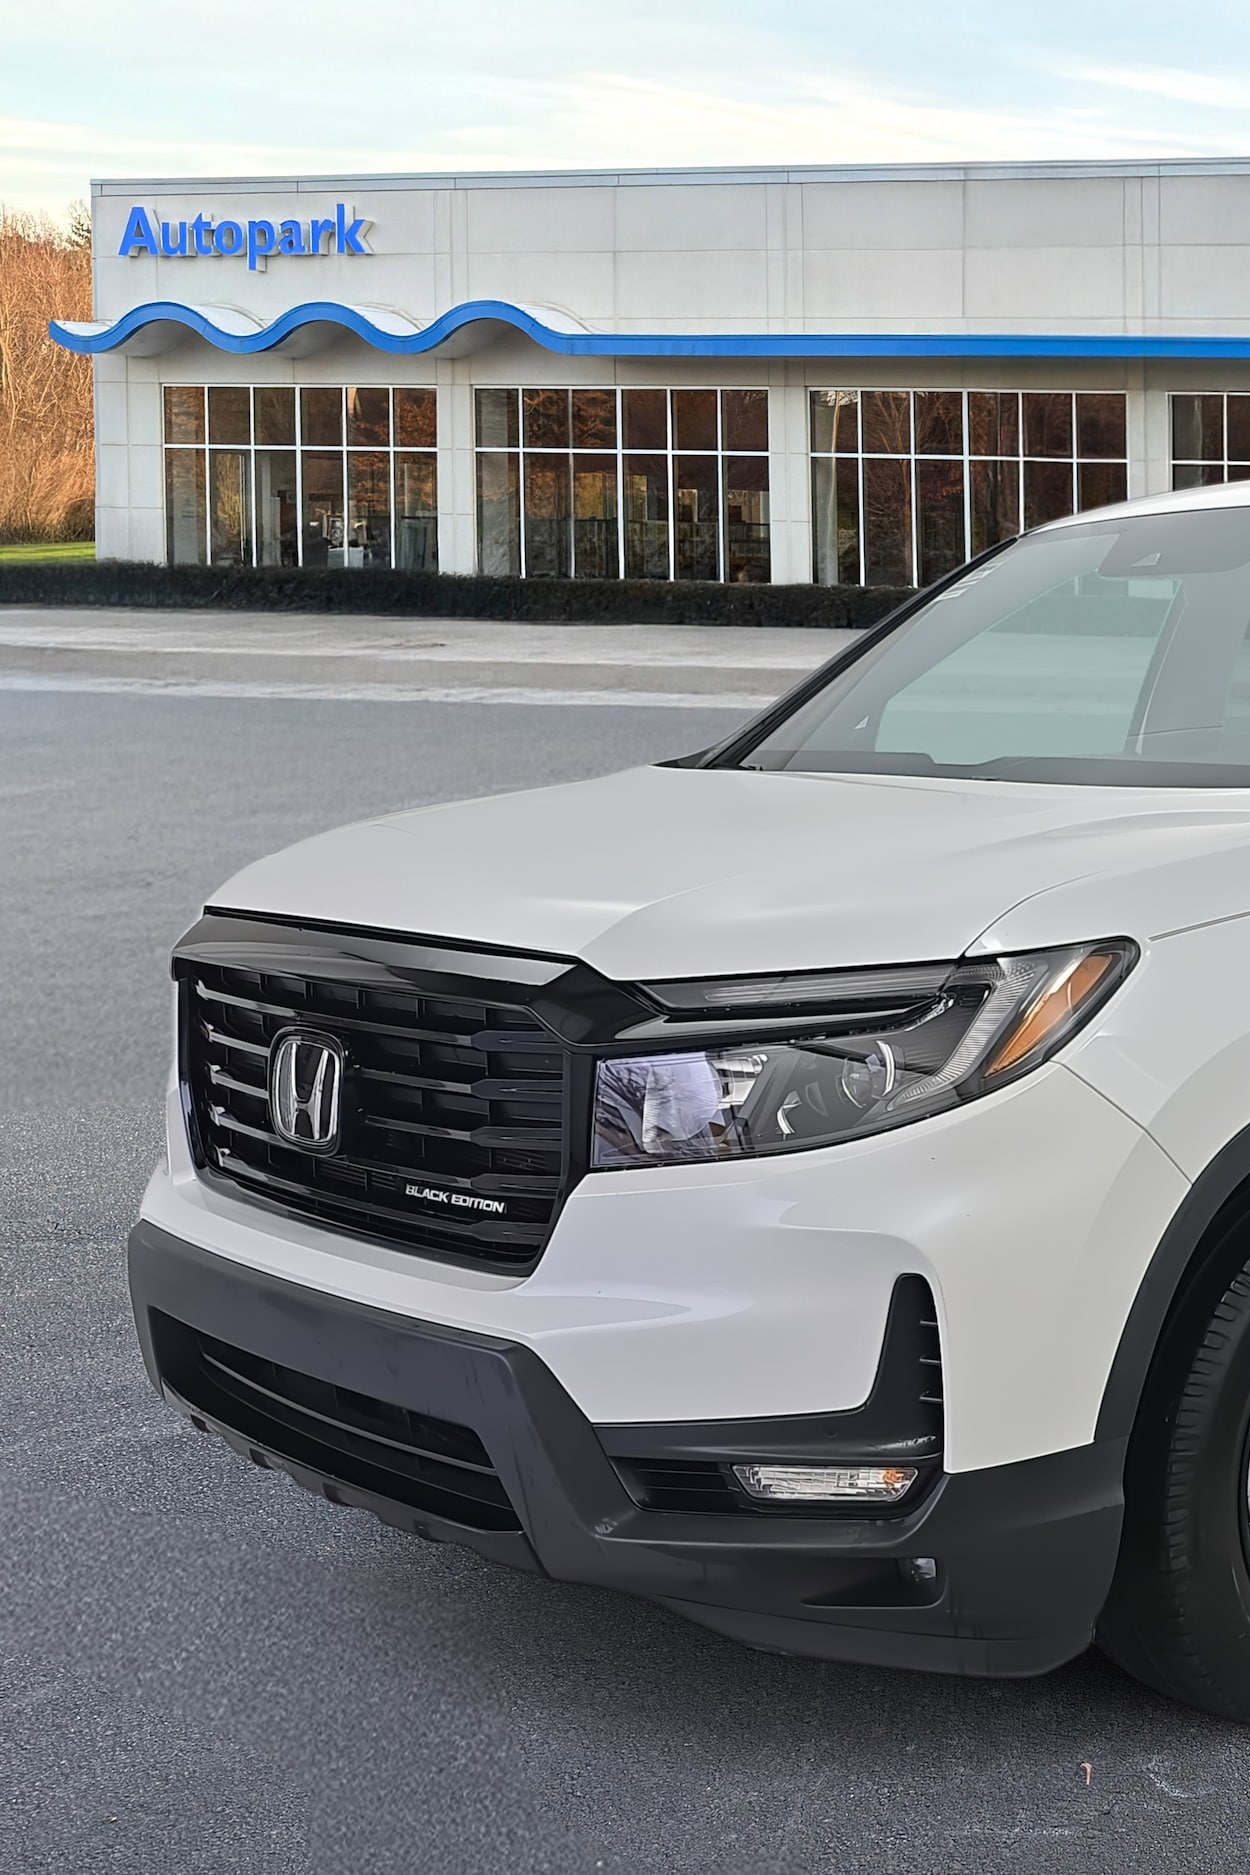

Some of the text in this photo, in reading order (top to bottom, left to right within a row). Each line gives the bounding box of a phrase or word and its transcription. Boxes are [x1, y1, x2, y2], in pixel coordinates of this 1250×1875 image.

[118, 202, 370, 272] Autopark
[405, 1184, 505, 1213] BLACK EDITION
